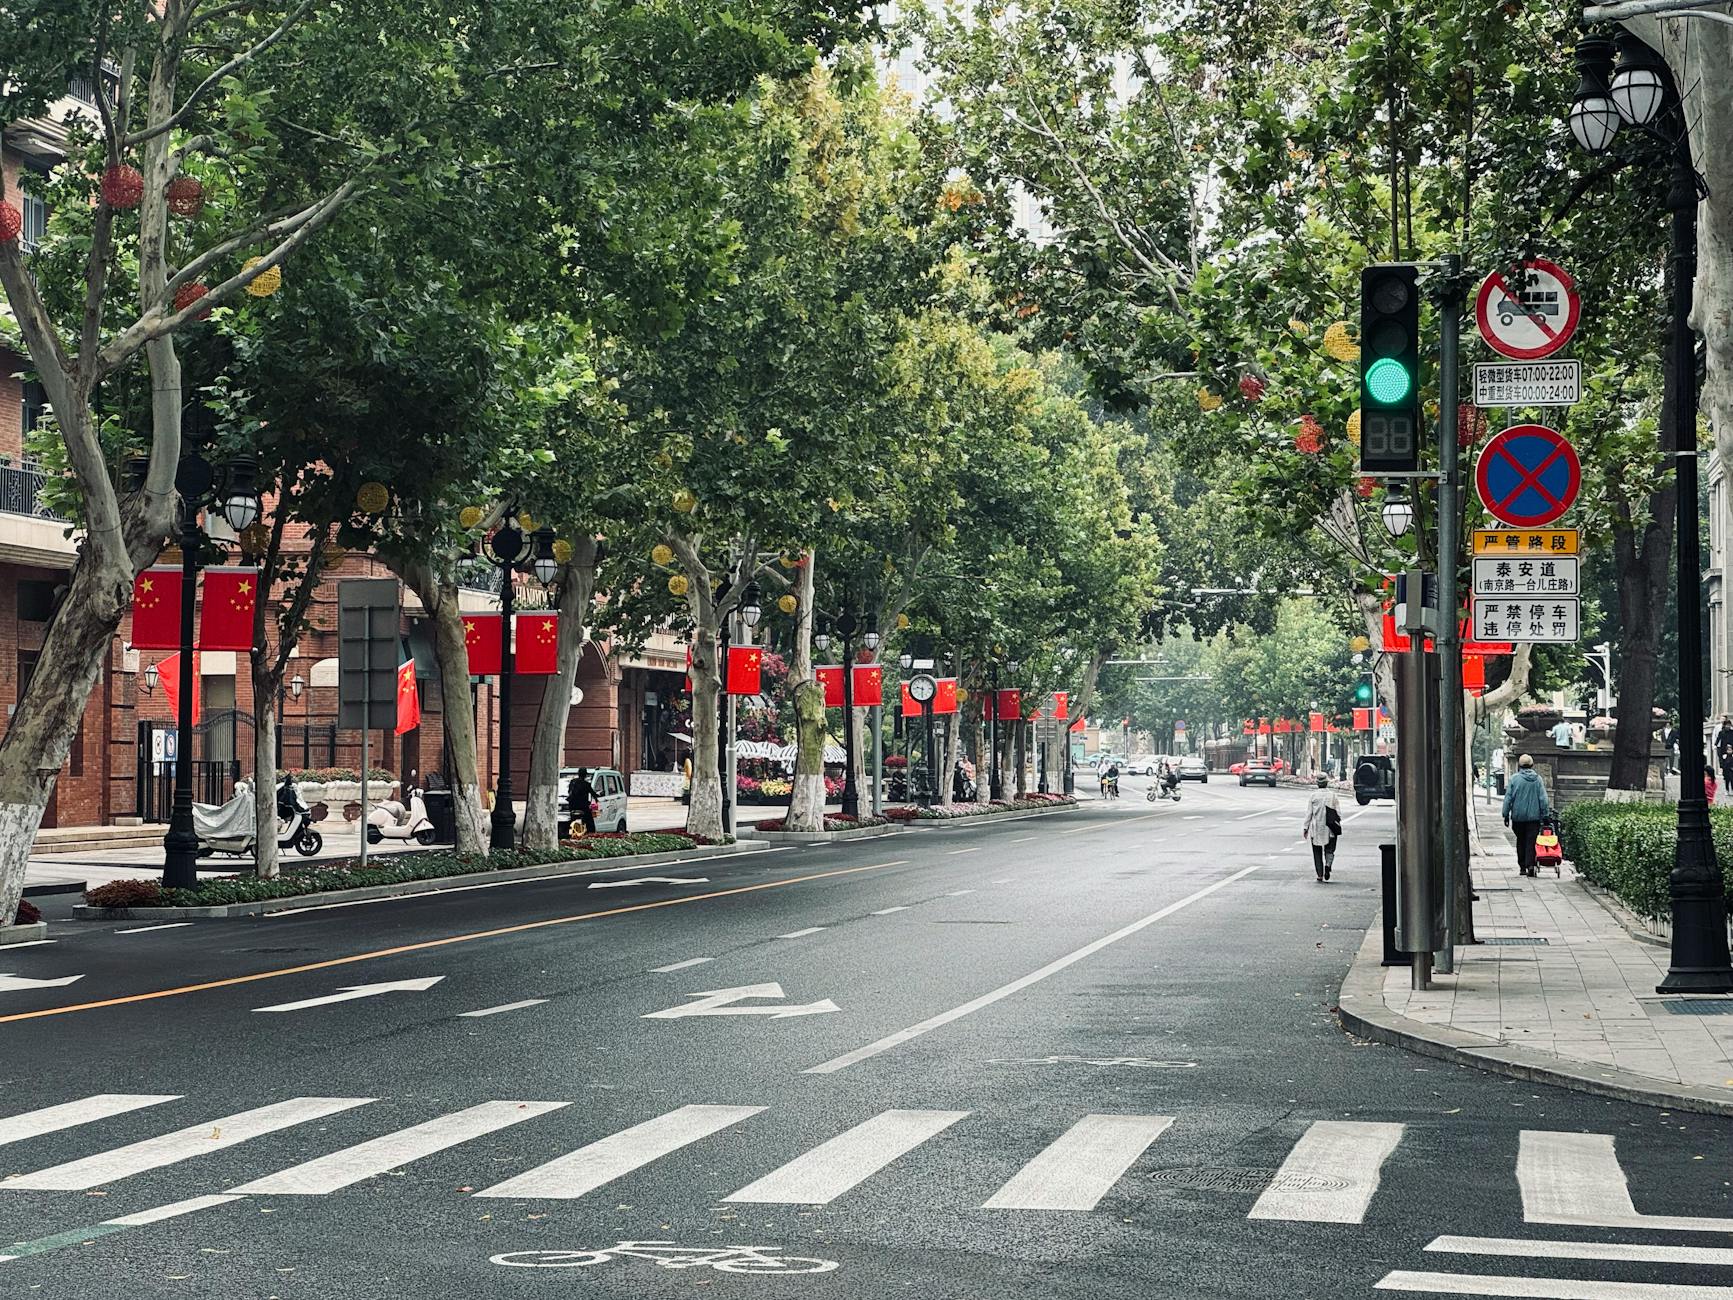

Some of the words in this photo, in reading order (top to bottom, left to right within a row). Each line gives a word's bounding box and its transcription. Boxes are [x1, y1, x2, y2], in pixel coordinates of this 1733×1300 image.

[1484, 535, 1567, 551] 严管路段
[1496, 562, 1556, 577] 泰安道
[1484, 604, 1567, 620] 严禁停车
[1484, 621, 1567, 637] 违停处罚
